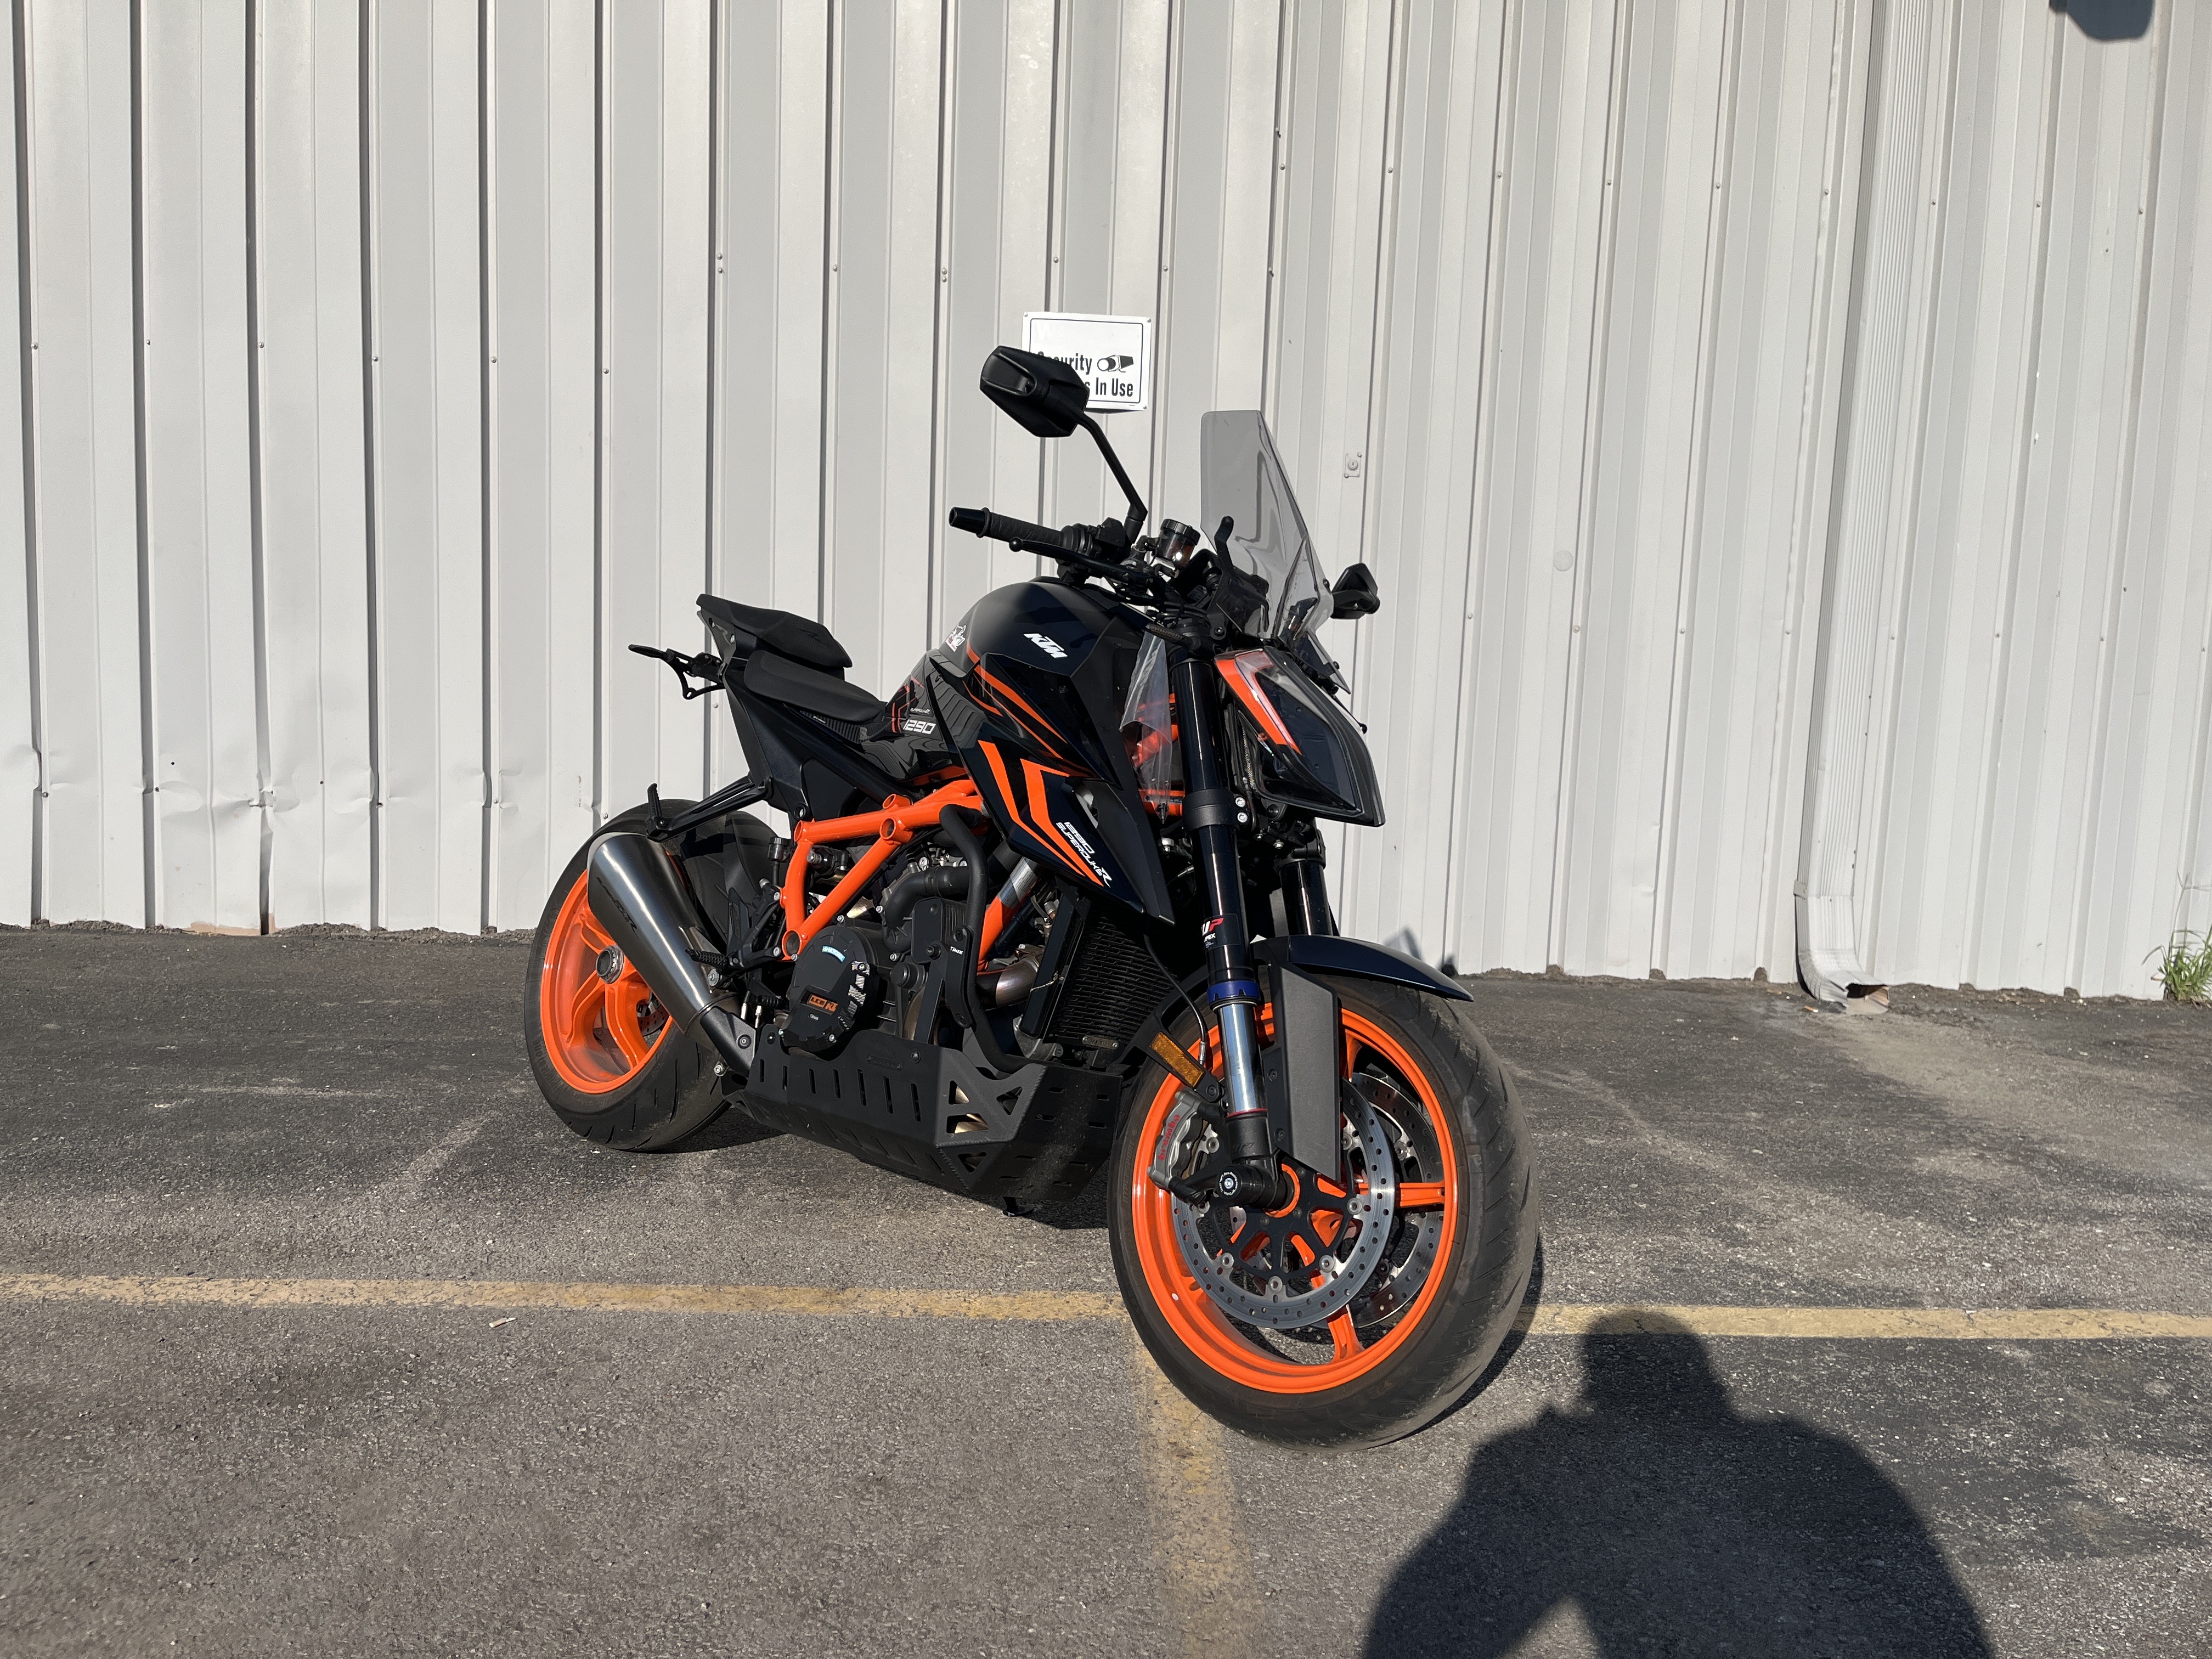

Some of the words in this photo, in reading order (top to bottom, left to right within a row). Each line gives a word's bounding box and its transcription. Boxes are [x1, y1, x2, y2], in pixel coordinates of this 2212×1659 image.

[1096, 377, 1107, 395] In
[1111, 378, 1133, 397] Use
[1023, 633, 1068, 658] KTM
[902, 719, 936, 735] 1290
[1064, 822, 1095, 854] 1290
[1157, 1114, 1181, 1160] brembo
